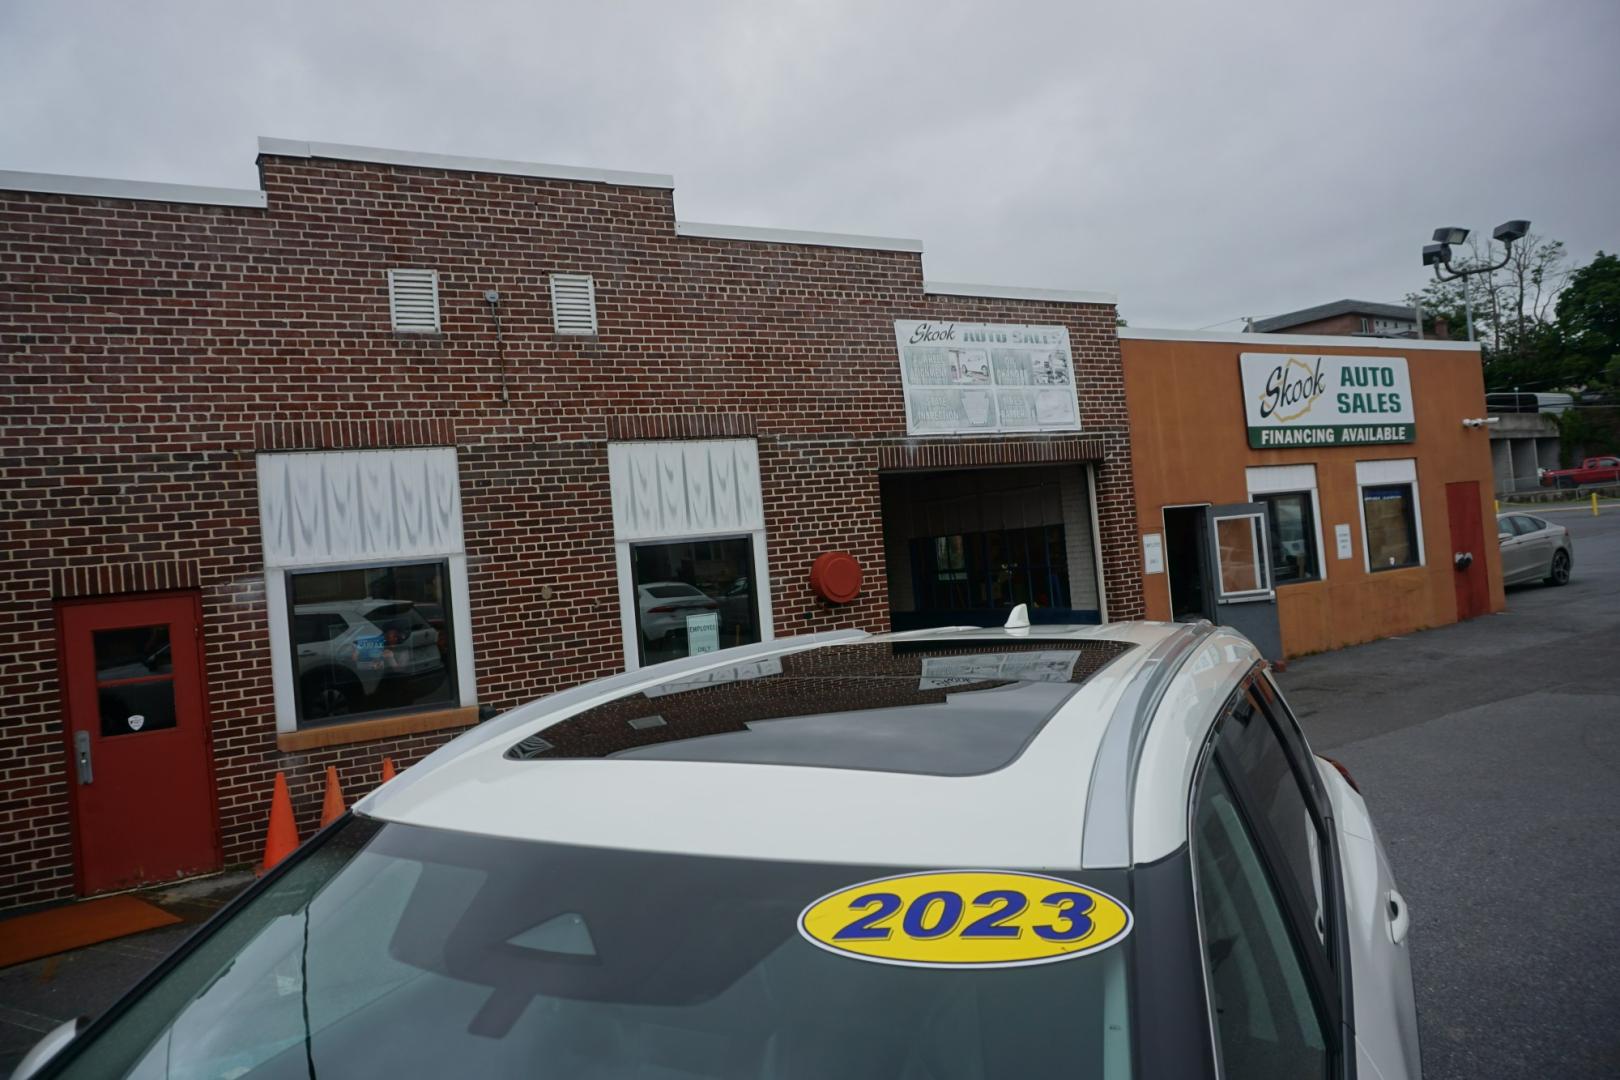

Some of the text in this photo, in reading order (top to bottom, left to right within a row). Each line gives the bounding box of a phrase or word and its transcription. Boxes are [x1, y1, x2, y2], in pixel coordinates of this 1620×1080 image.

[909, 323, 1062, 344] Skook AUTO SALES
[1341, 366, 1394, 387] AUTO
[1260, 357, 1326, 418] Skook
[1337, 393, 1402, 414] SALES
[1261, 426, 1406, 445] FINANCING AVAILABLE
[832, 890, 1096, 942] 2023
